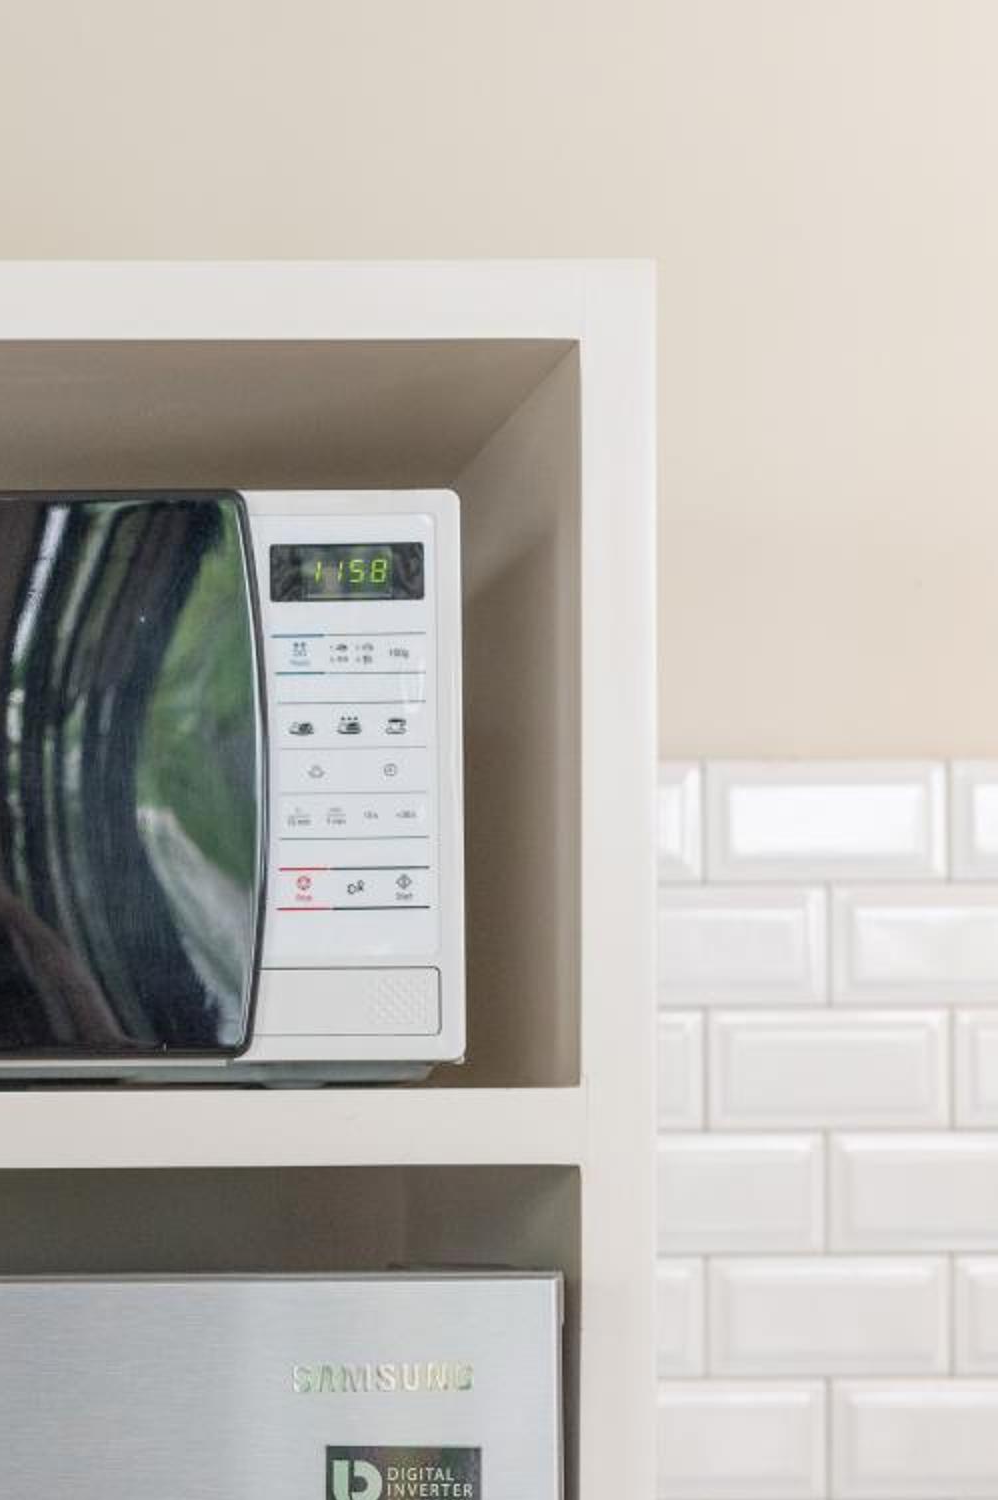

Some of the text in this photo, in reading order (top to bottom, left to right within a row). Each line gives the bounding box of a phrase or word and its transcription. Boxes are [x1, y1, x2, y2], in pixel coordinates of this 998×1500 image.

[293, 1362, 474, 1393] SAMSUNG
[386, 1467, 455, 1481] DIGITAL
[386, 1483, 474, 1498] INVERTER
